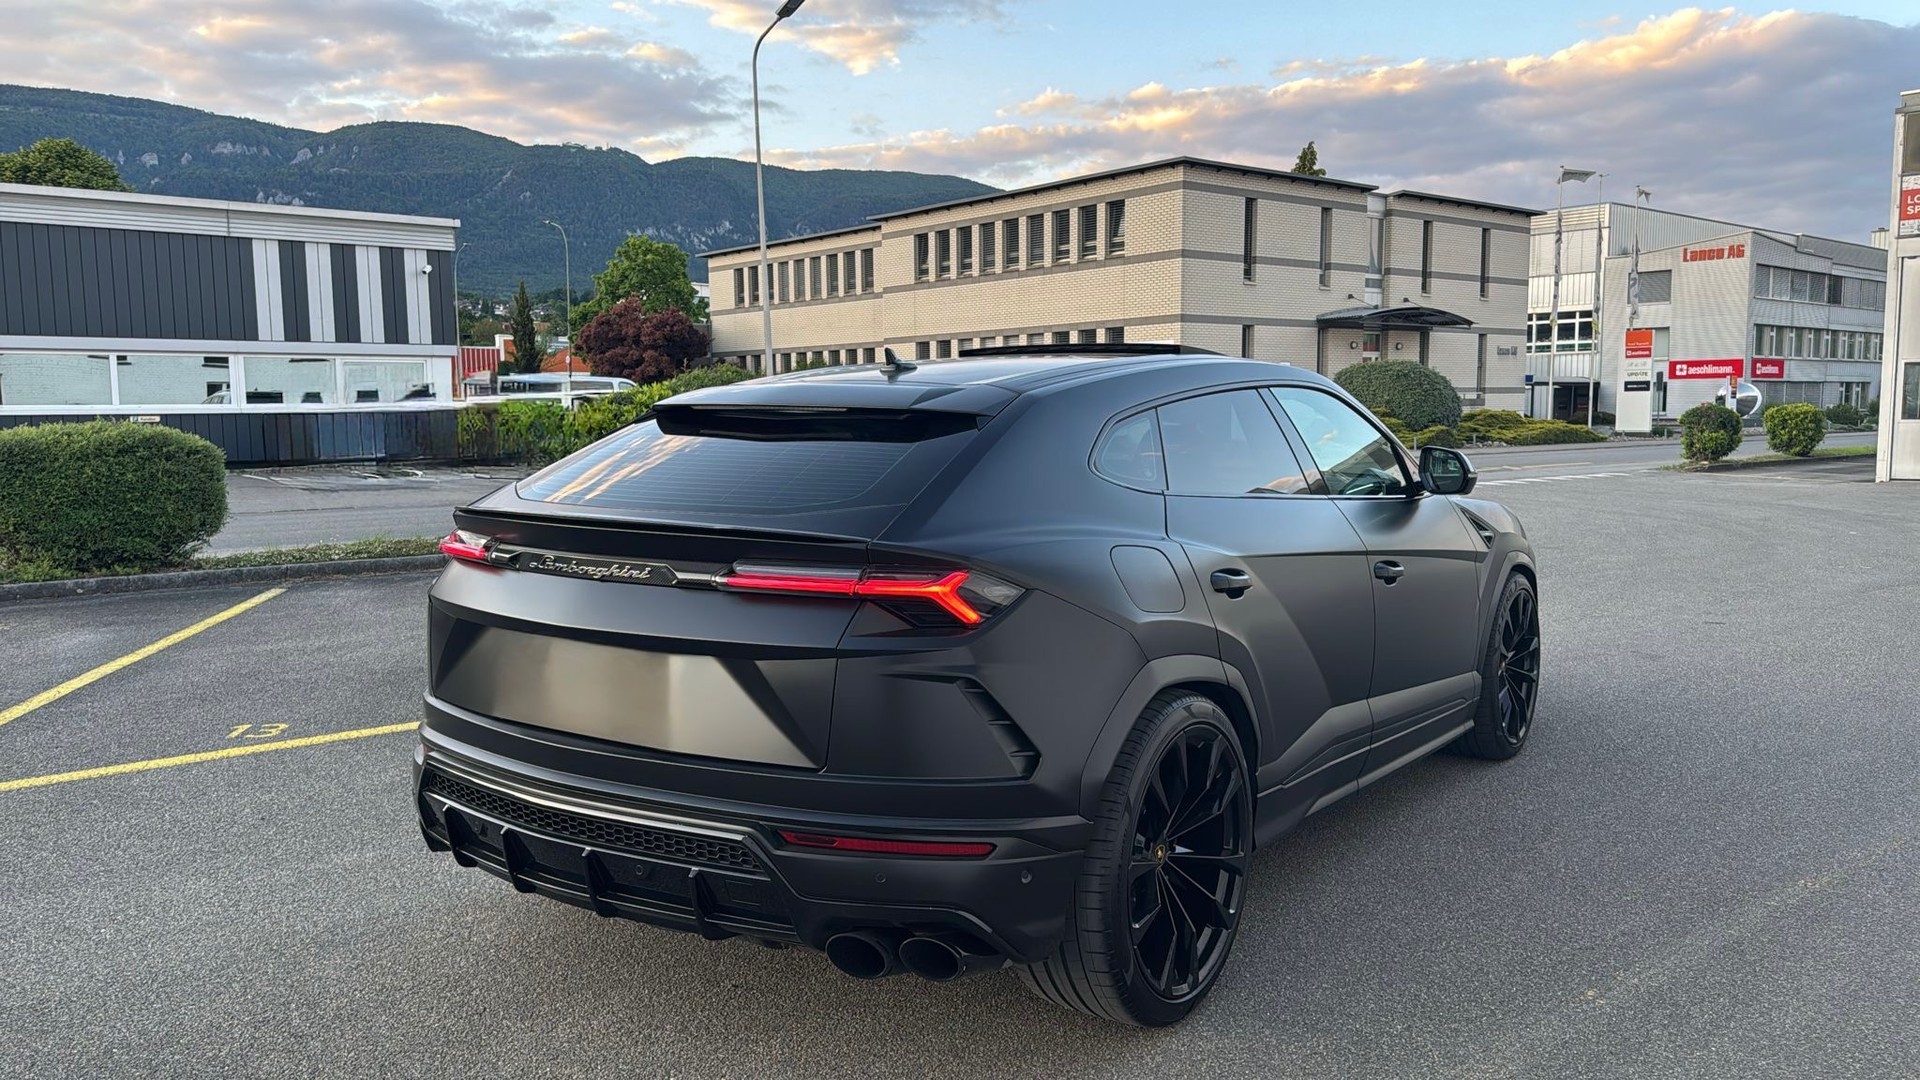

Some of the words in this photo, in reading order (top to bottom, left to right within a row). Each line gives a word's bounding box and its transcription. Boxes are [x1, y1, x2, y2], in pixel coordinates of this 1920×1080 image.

[1682, 247, 1725, 262] Lanco
[1727, 244, 1745, 259] AG
[529, 554, 651, 578] Lamborghini
[225, 723, 290, 739] 13
